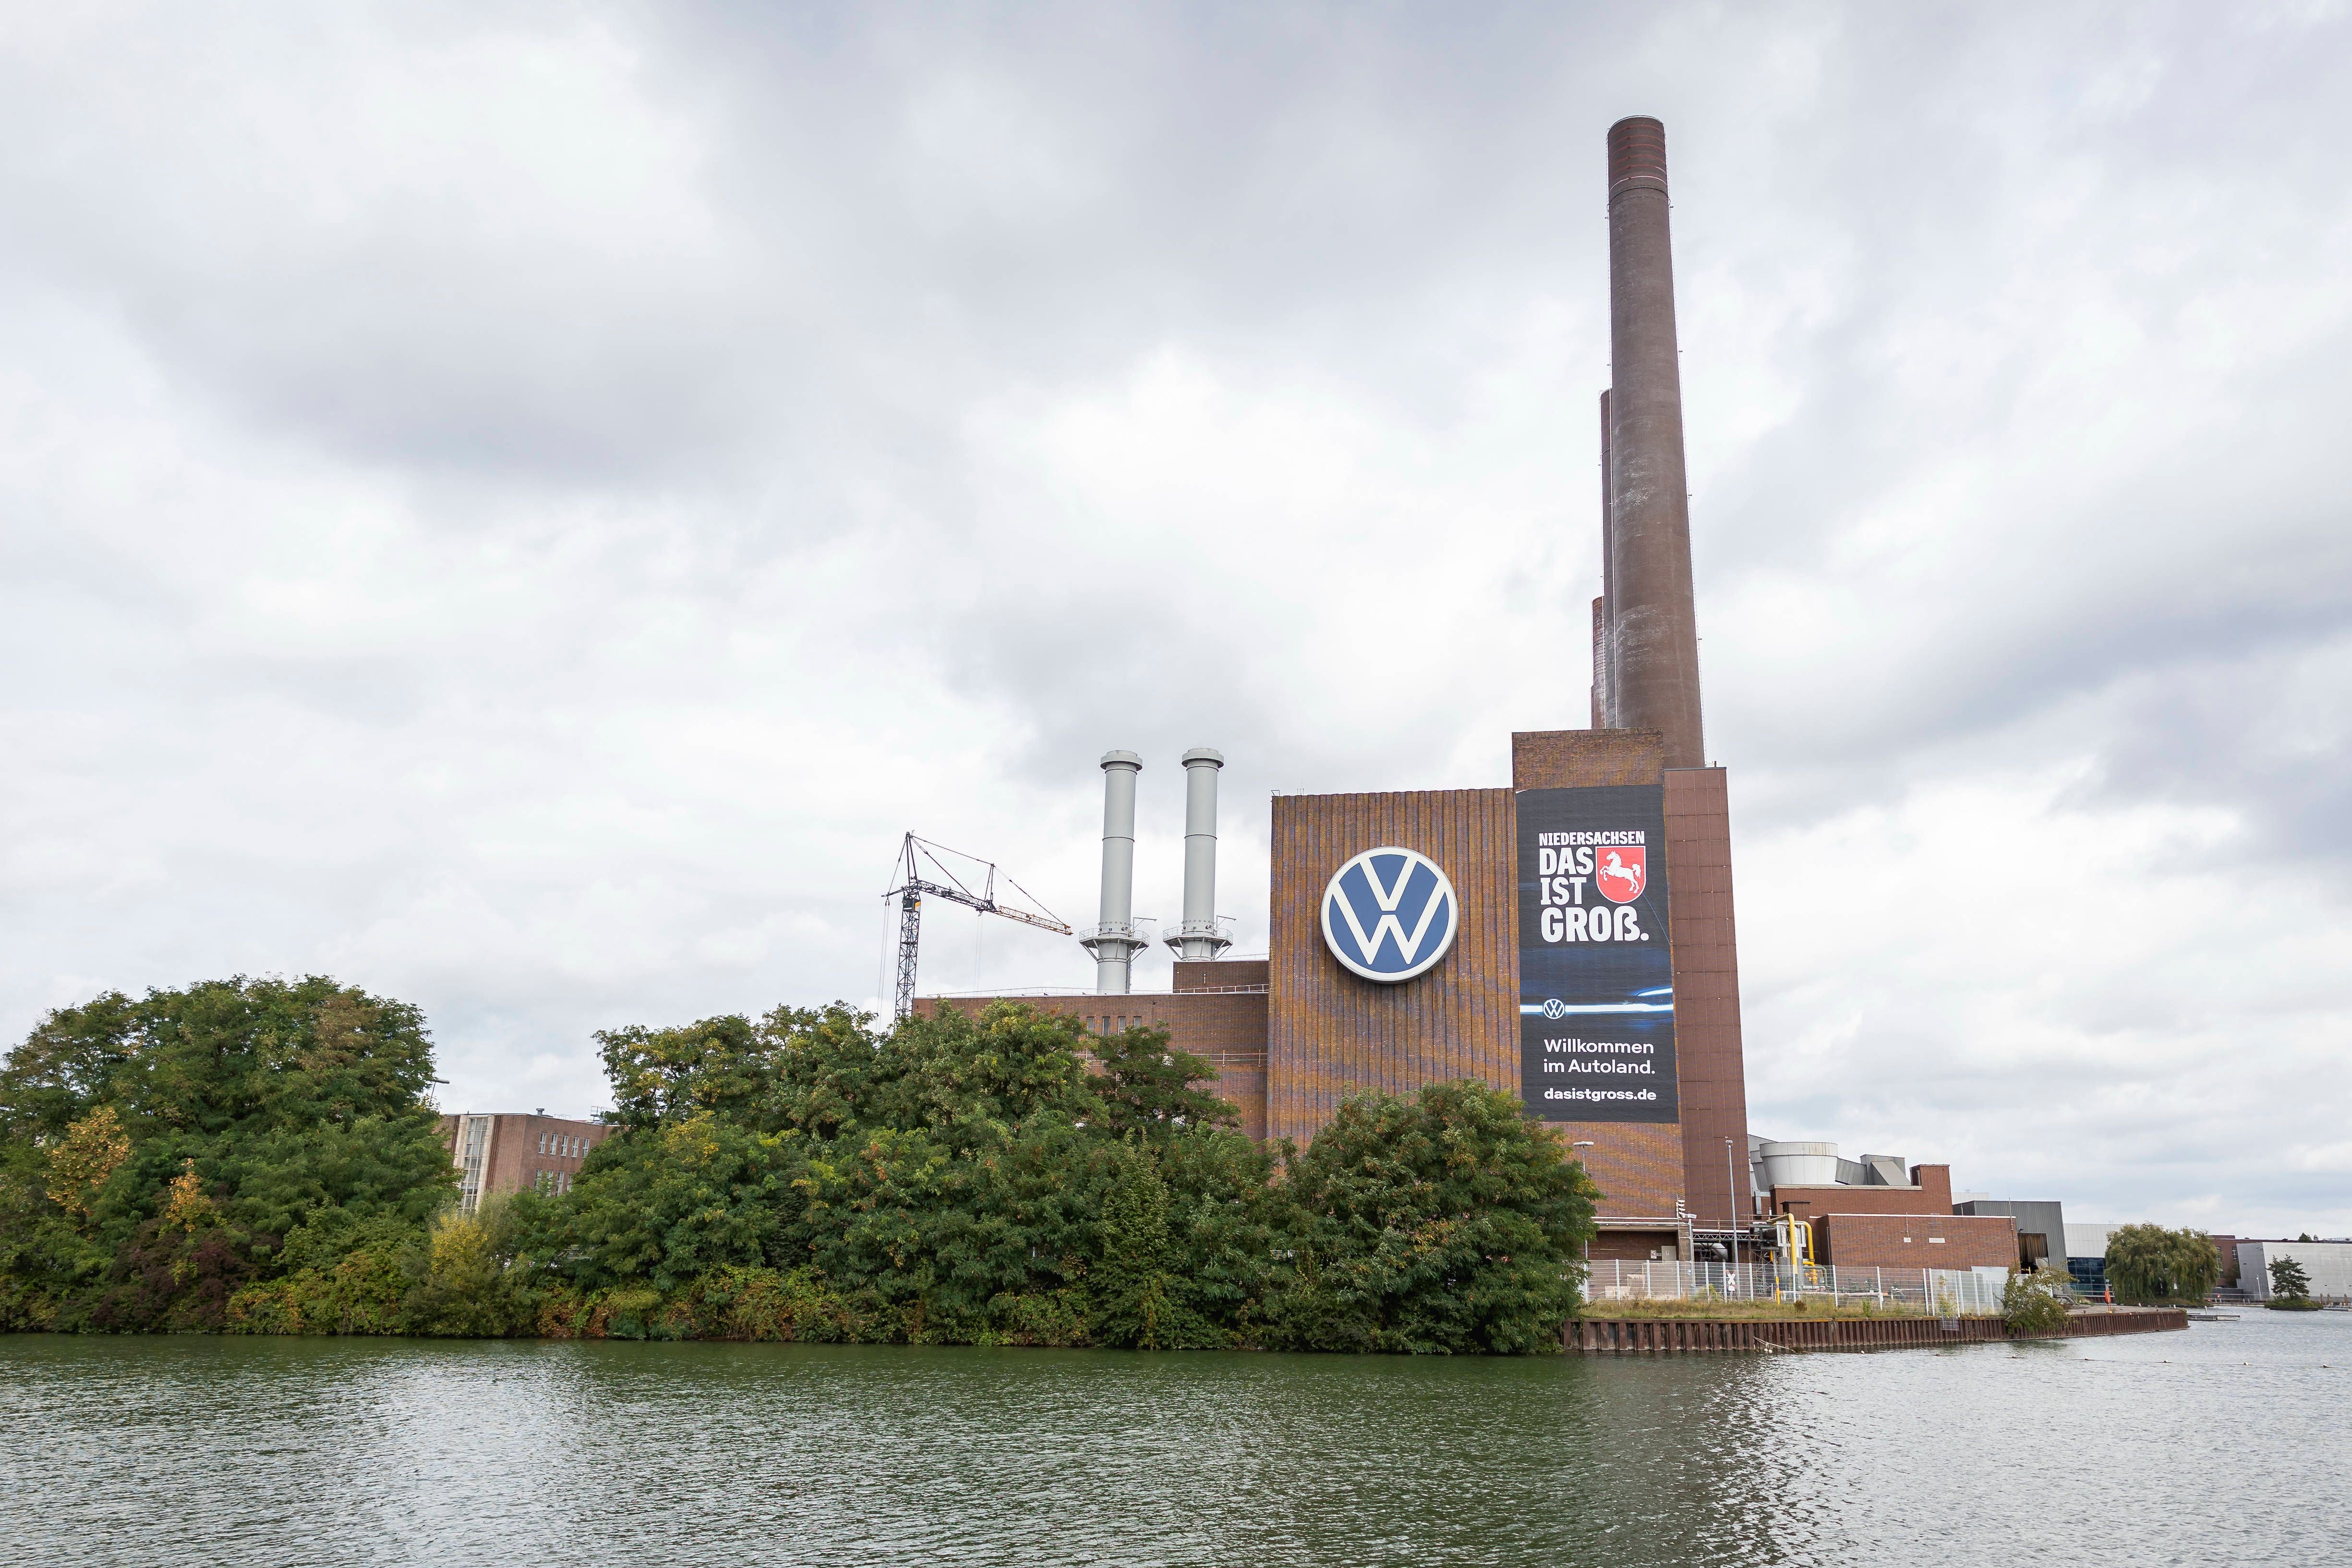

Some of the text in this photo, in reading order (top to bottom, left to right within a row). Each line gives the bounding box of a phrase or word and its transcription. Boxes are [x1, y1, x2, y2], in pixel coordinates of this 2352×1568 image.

[1539, 831, 1645, 846] NIEDERSACHSEN
[1539, 846, 1594, 875] DAS
[1540, 877, 1587, 905] IST
[1326, 851, 1453, 973] VW
[1544, 999, 1564, 1019] VW
[1544, 1038, 1654, 1054] Willkommen
[1544, 1058, 1655, 1074] im Autoland.
[1544, 1087, 1657, 1102] dasistgross.de
